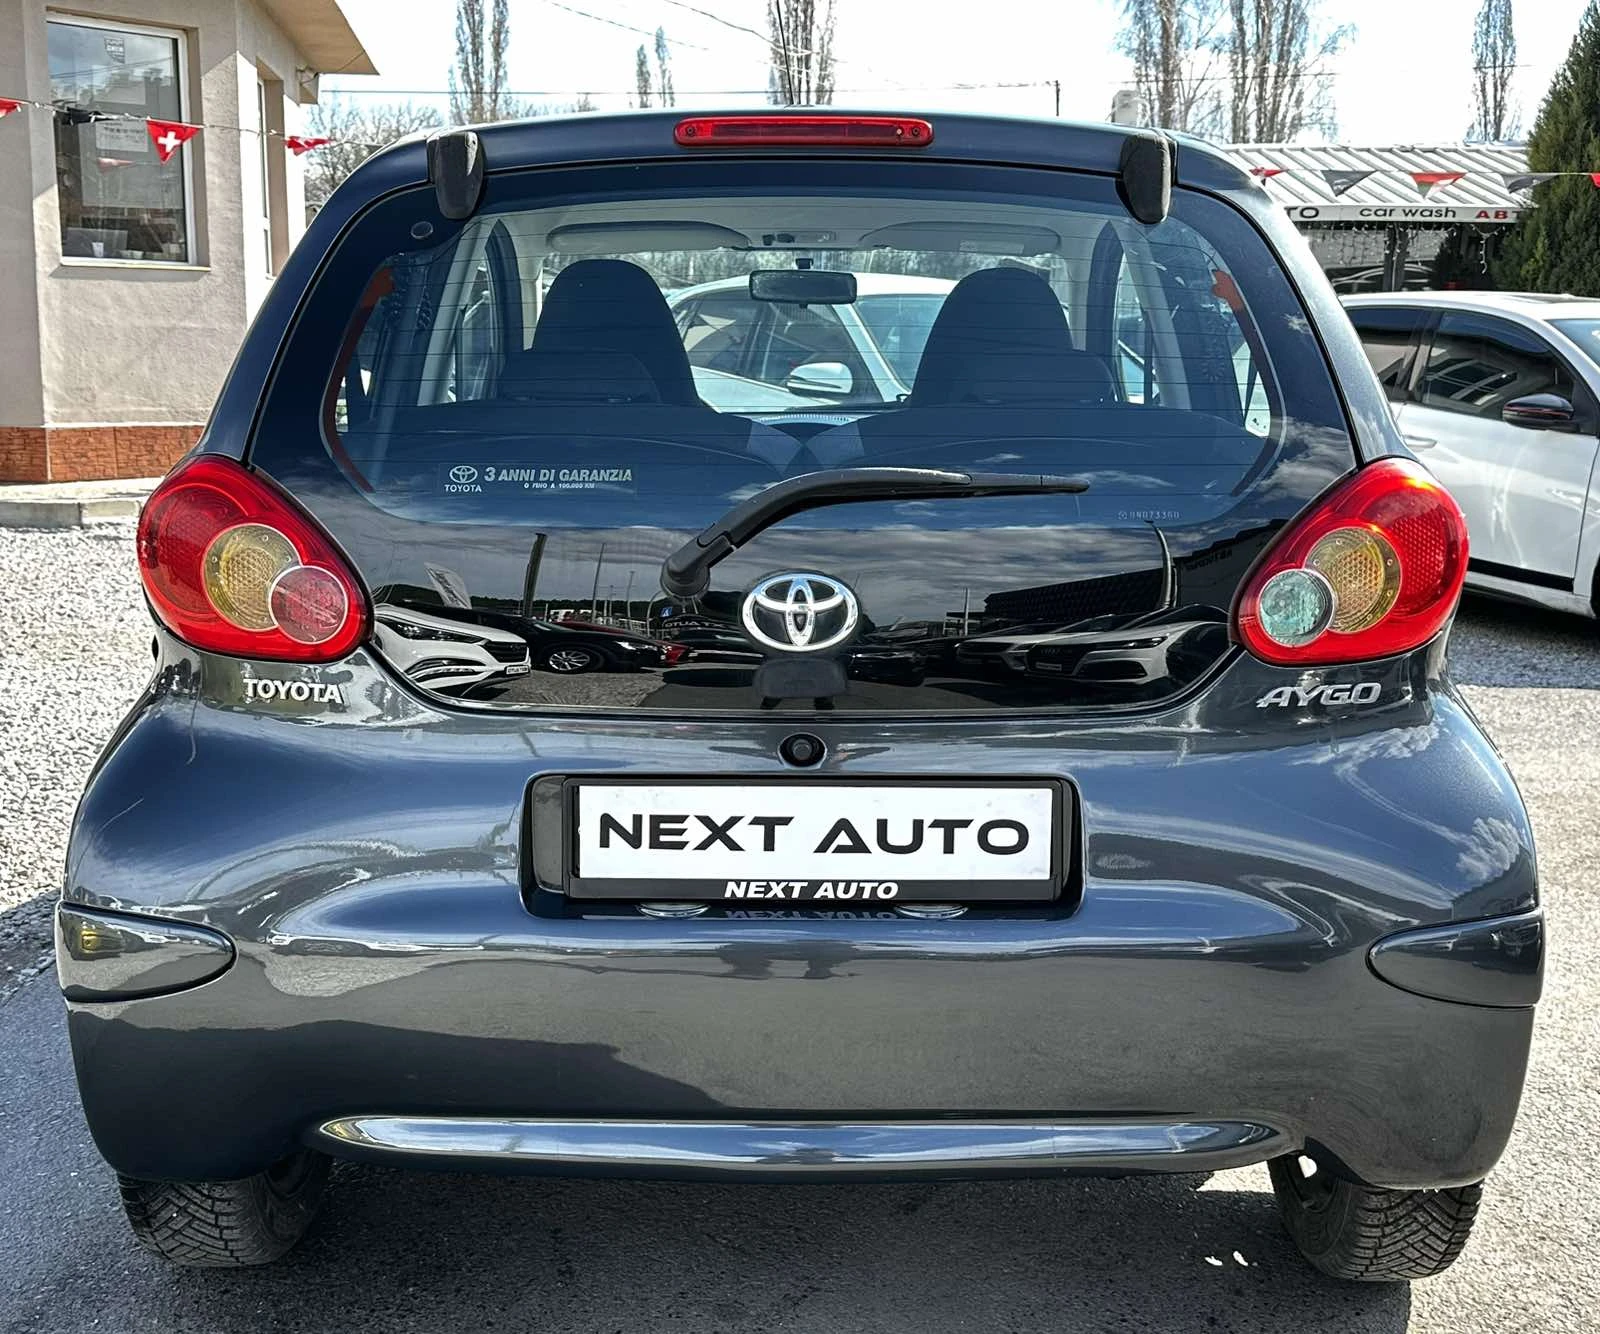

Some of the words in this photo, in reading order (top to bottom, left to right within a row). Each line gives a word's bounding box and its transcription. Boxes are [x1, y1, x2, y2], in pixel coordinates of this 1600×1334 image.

[1359, 207, 1396, 217] car
[1402, 207, 1457, 218] wash
[484, 466, 496, 481] 3
[498, 469, 535, 482] ANNI
[539, 469, 556, 482] DI
[559, 469, 633, 482] GARANZIA
[444, 484, 482, 493] TOYOTA
[243, 678, 342, 704] TOYOTA
[1256, 682, 1382, 708] AYGO
[600, 813, 794, 852] NEXT
[813, 817, 1029, 856] AUTO
[724, 881, 808, 898] NEXT
[813, 882, 899, 899] AUTO
